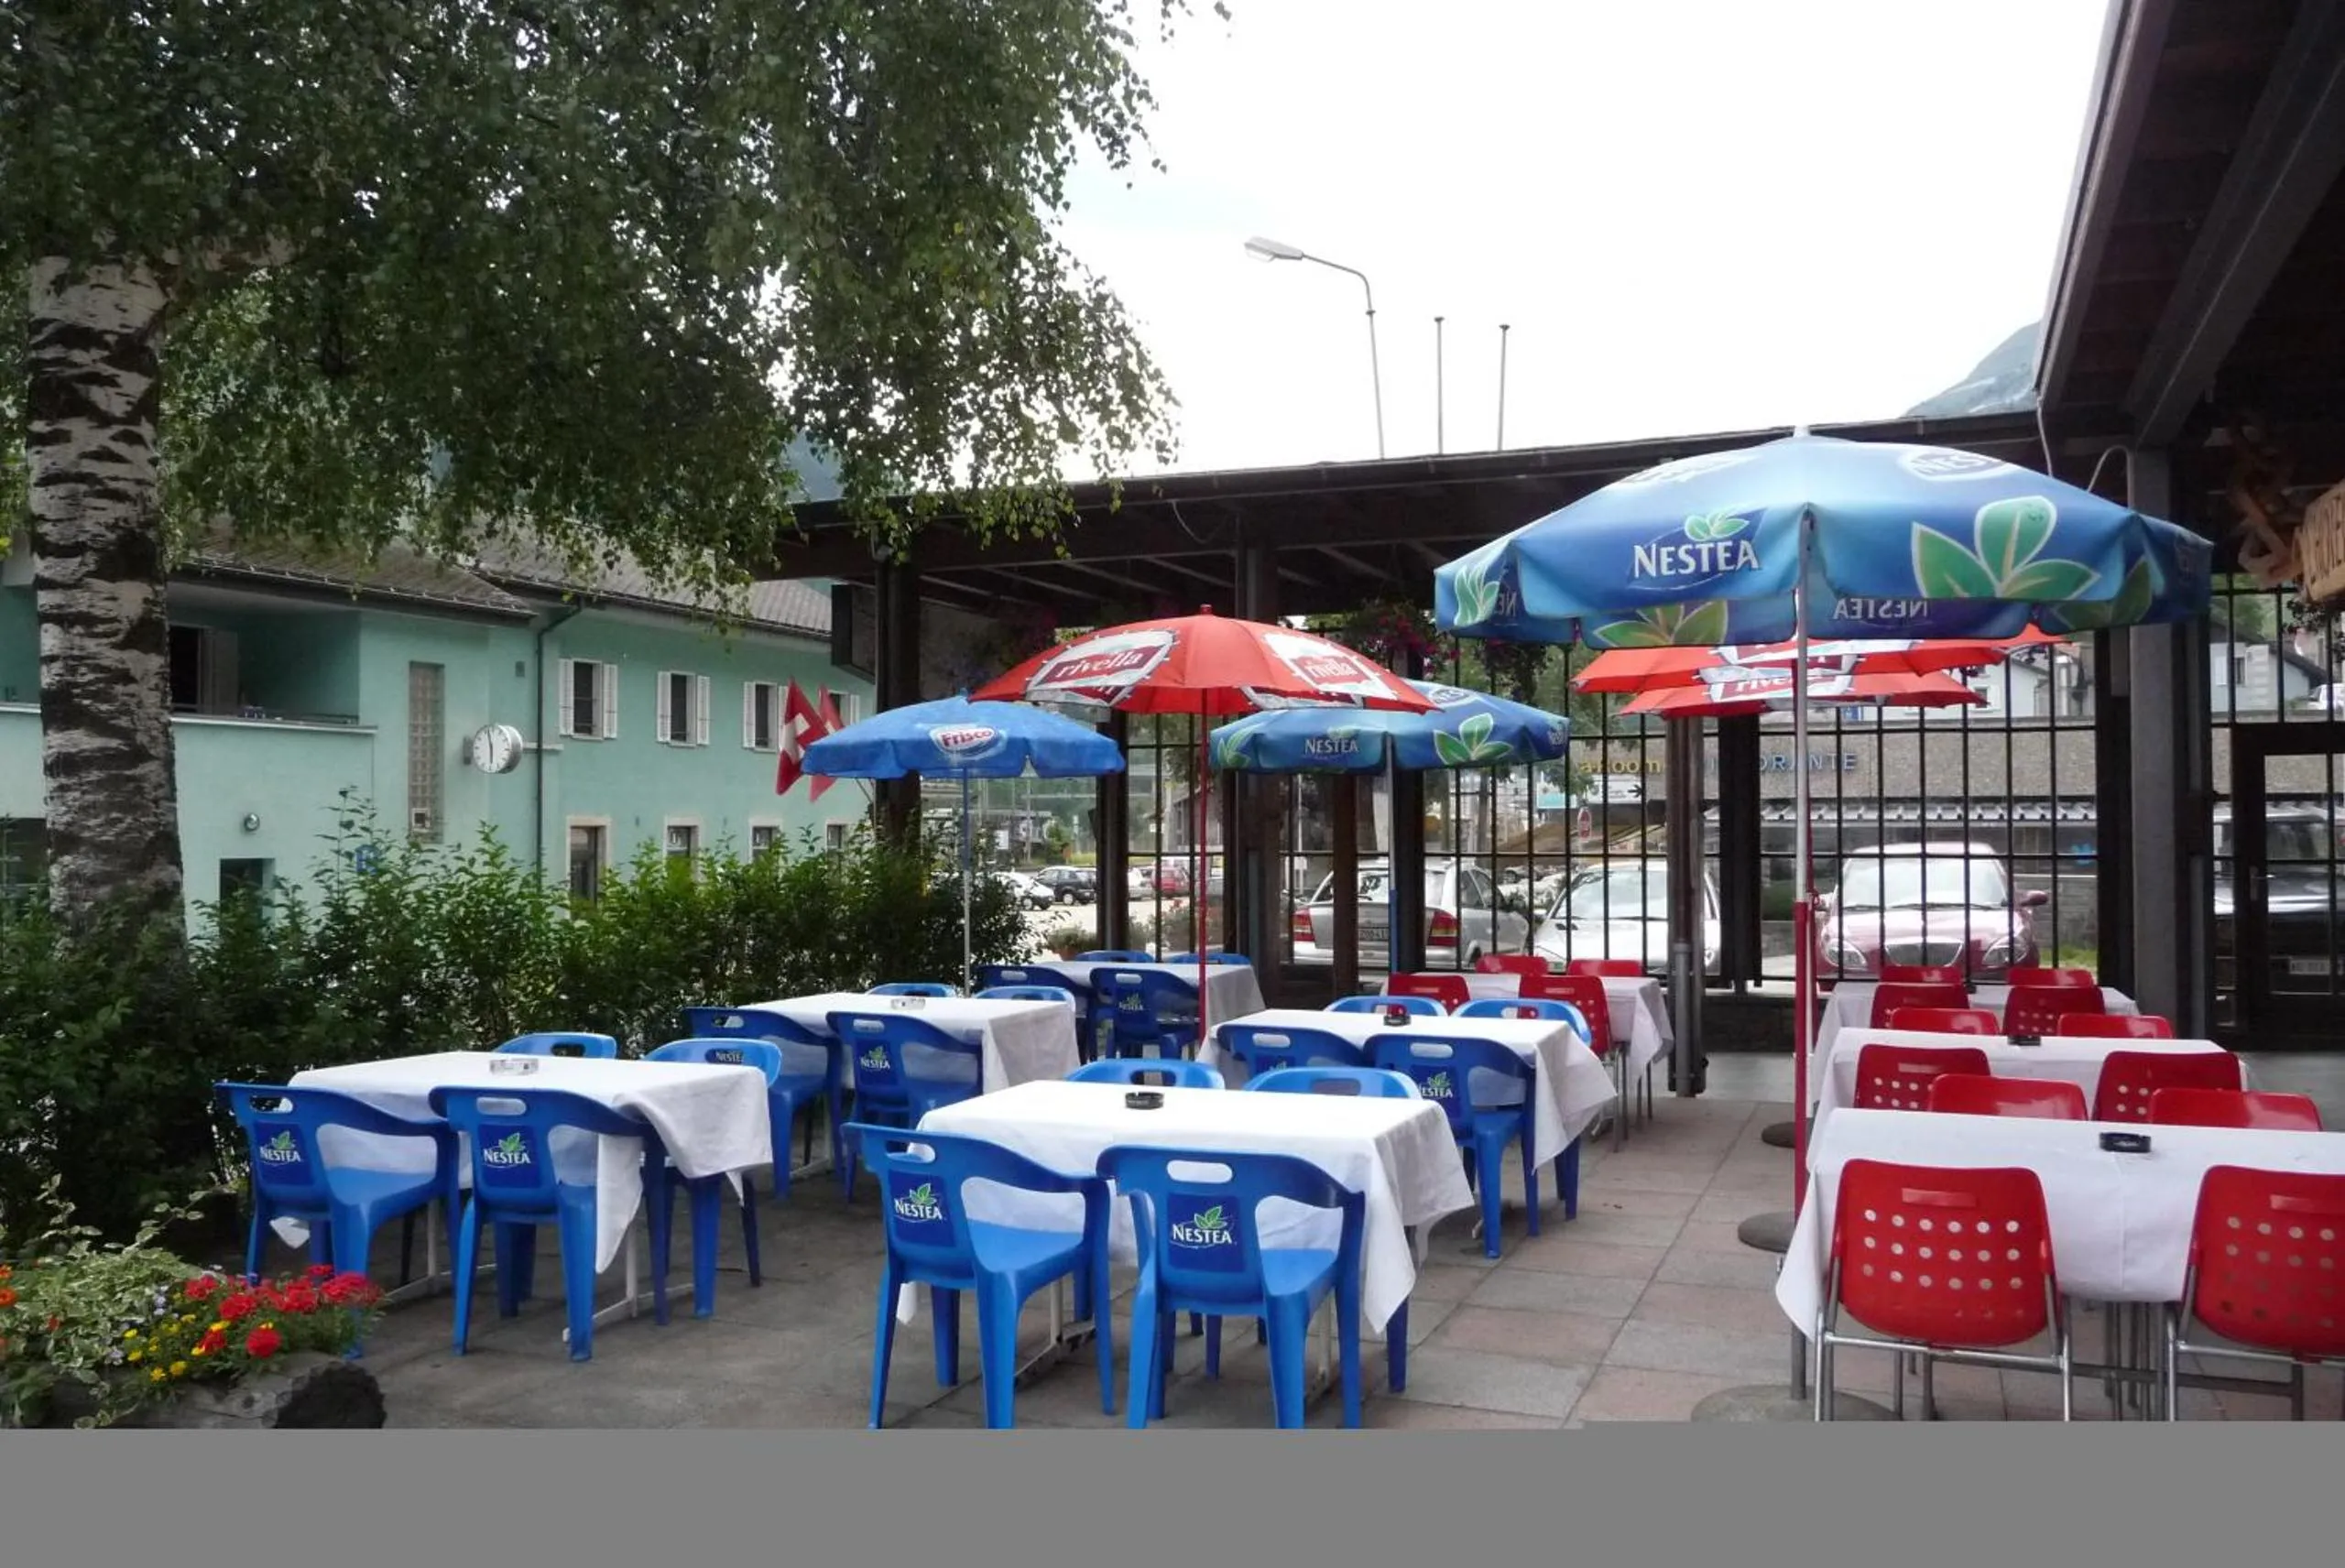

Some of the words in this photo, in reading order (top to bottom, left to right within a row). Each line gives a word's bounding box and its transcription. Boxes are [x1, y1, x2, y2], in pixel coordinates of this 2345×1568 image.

[1633, 539, 1760, 579] NESTEA
[1054, 650, 1144, 679] rivella
[941, 731, 992, 747] Frisco
[1304, 737, 1360, 755] NESTEA
[258, 1146, 302, 1163] NESTEA
[483, 1148, 531, 1164] NESTEA
[893, 1197, 943, 1221] NESTEA
[1172, 1223, 1233, 1245] NESTEA
